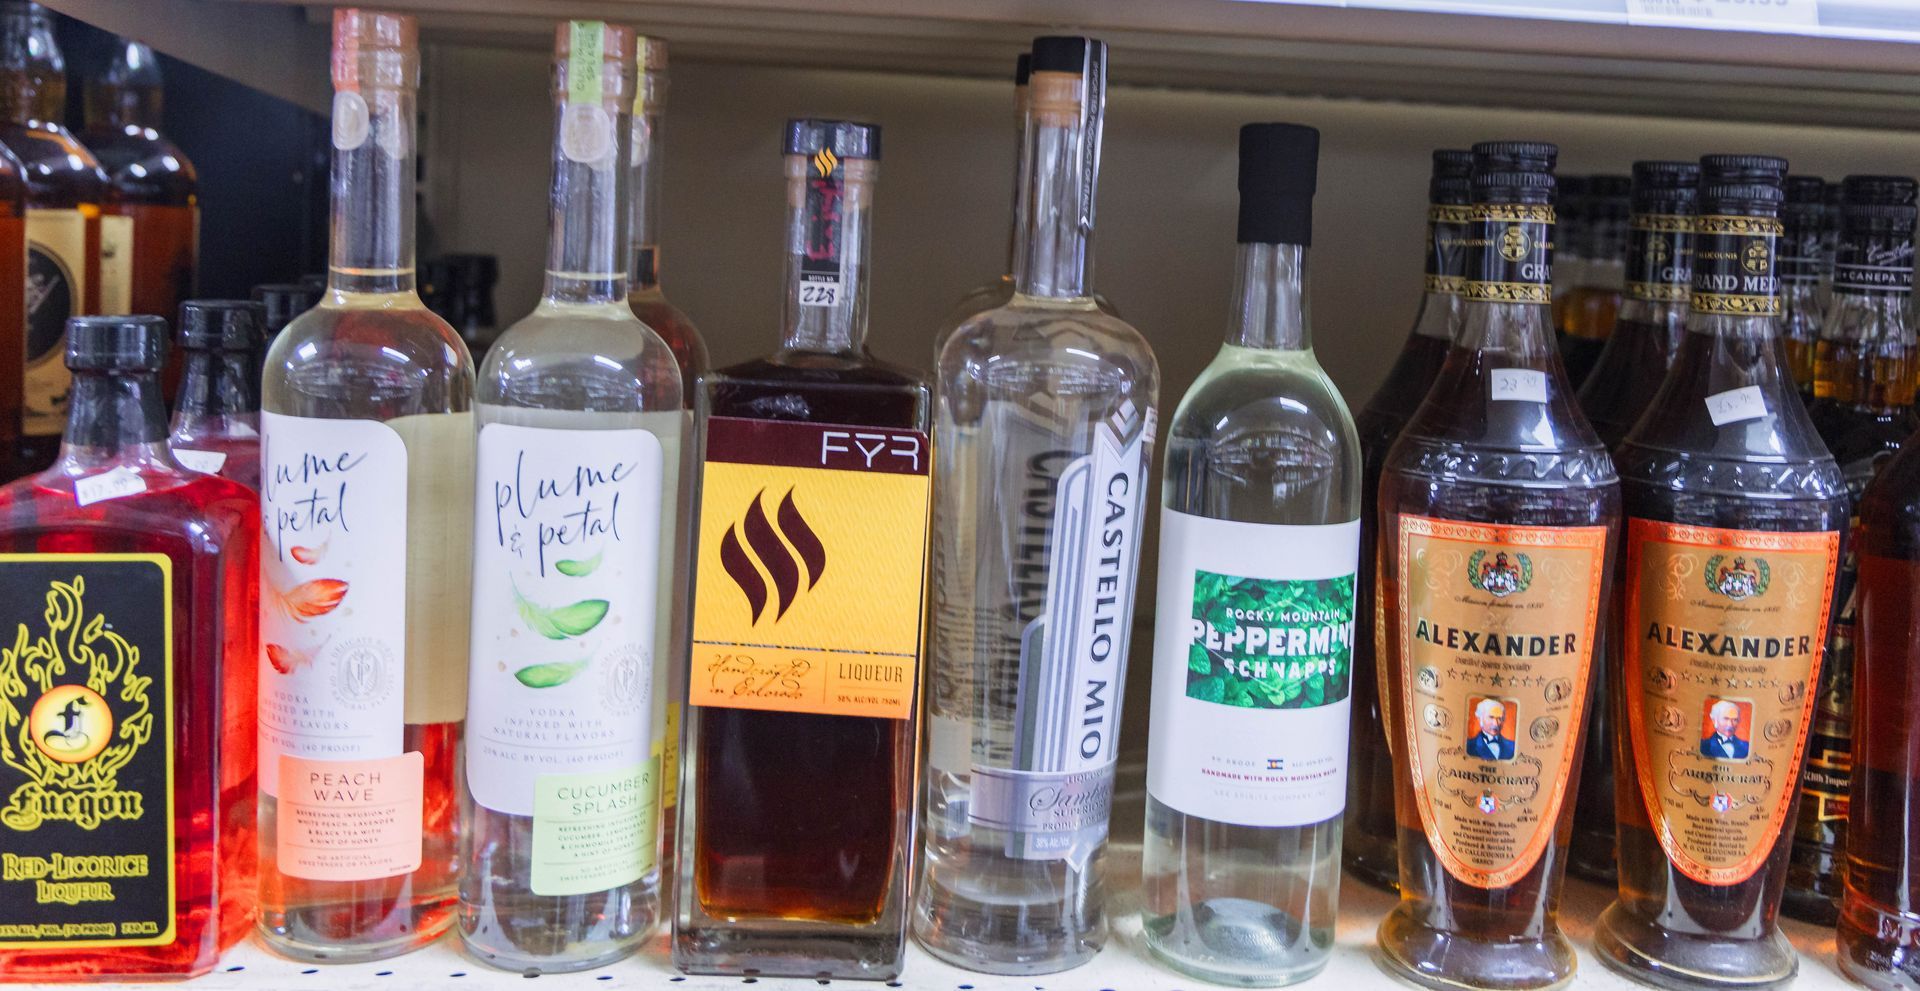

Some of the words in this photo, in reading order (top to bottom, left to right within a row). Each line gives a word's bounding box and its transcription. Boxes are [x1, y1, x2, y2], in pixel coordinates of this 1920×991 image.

[1848, 269, 1897, 282] CANEPA
[803, 286, 835, 304] 228
[821, 430, 920, 471] FYR
[262, 434, 368, 501] lume
[495, 450, 639, 547] plume
[538, 492, 620, 578] petal
[1089, 472, 1129, 663] CASTELLO
[1226, 608, 1274, 622] ROCKY
[1281, 608, 1340, 622] MOUNTAIN
[1415, 618, 1577, 657] ALEXANDER
[1647, 620, 1810, 658] ALEXANDER
[839, 662, 902, 683] LIQUEUR
[1224, 658, 1336, 680] SCHNAPPS
[303, 709, 335, 718] WITH
[530, 707, 576, 717] VODKA
[1080, 680, 1107, 760] MIO
[293, 719, 350, 730] FLAVORS
[505, 718, 560, 728] INFUSED
[568, 719, 602, 728] WITH
[493, 727, 548, 740] NATURAL
[556, 730, 616, 741] FLAVORS
[310, 772, 381, 786] PEACH
[1479, 765, 1497, 773] THE
[314, 788, 374, 801] WAVE
[557, 772, 650, 800] CUCUMBER
[572, 793, 638, 816] SPLASH
[36, 880, 115, 905] LIQUEUR
